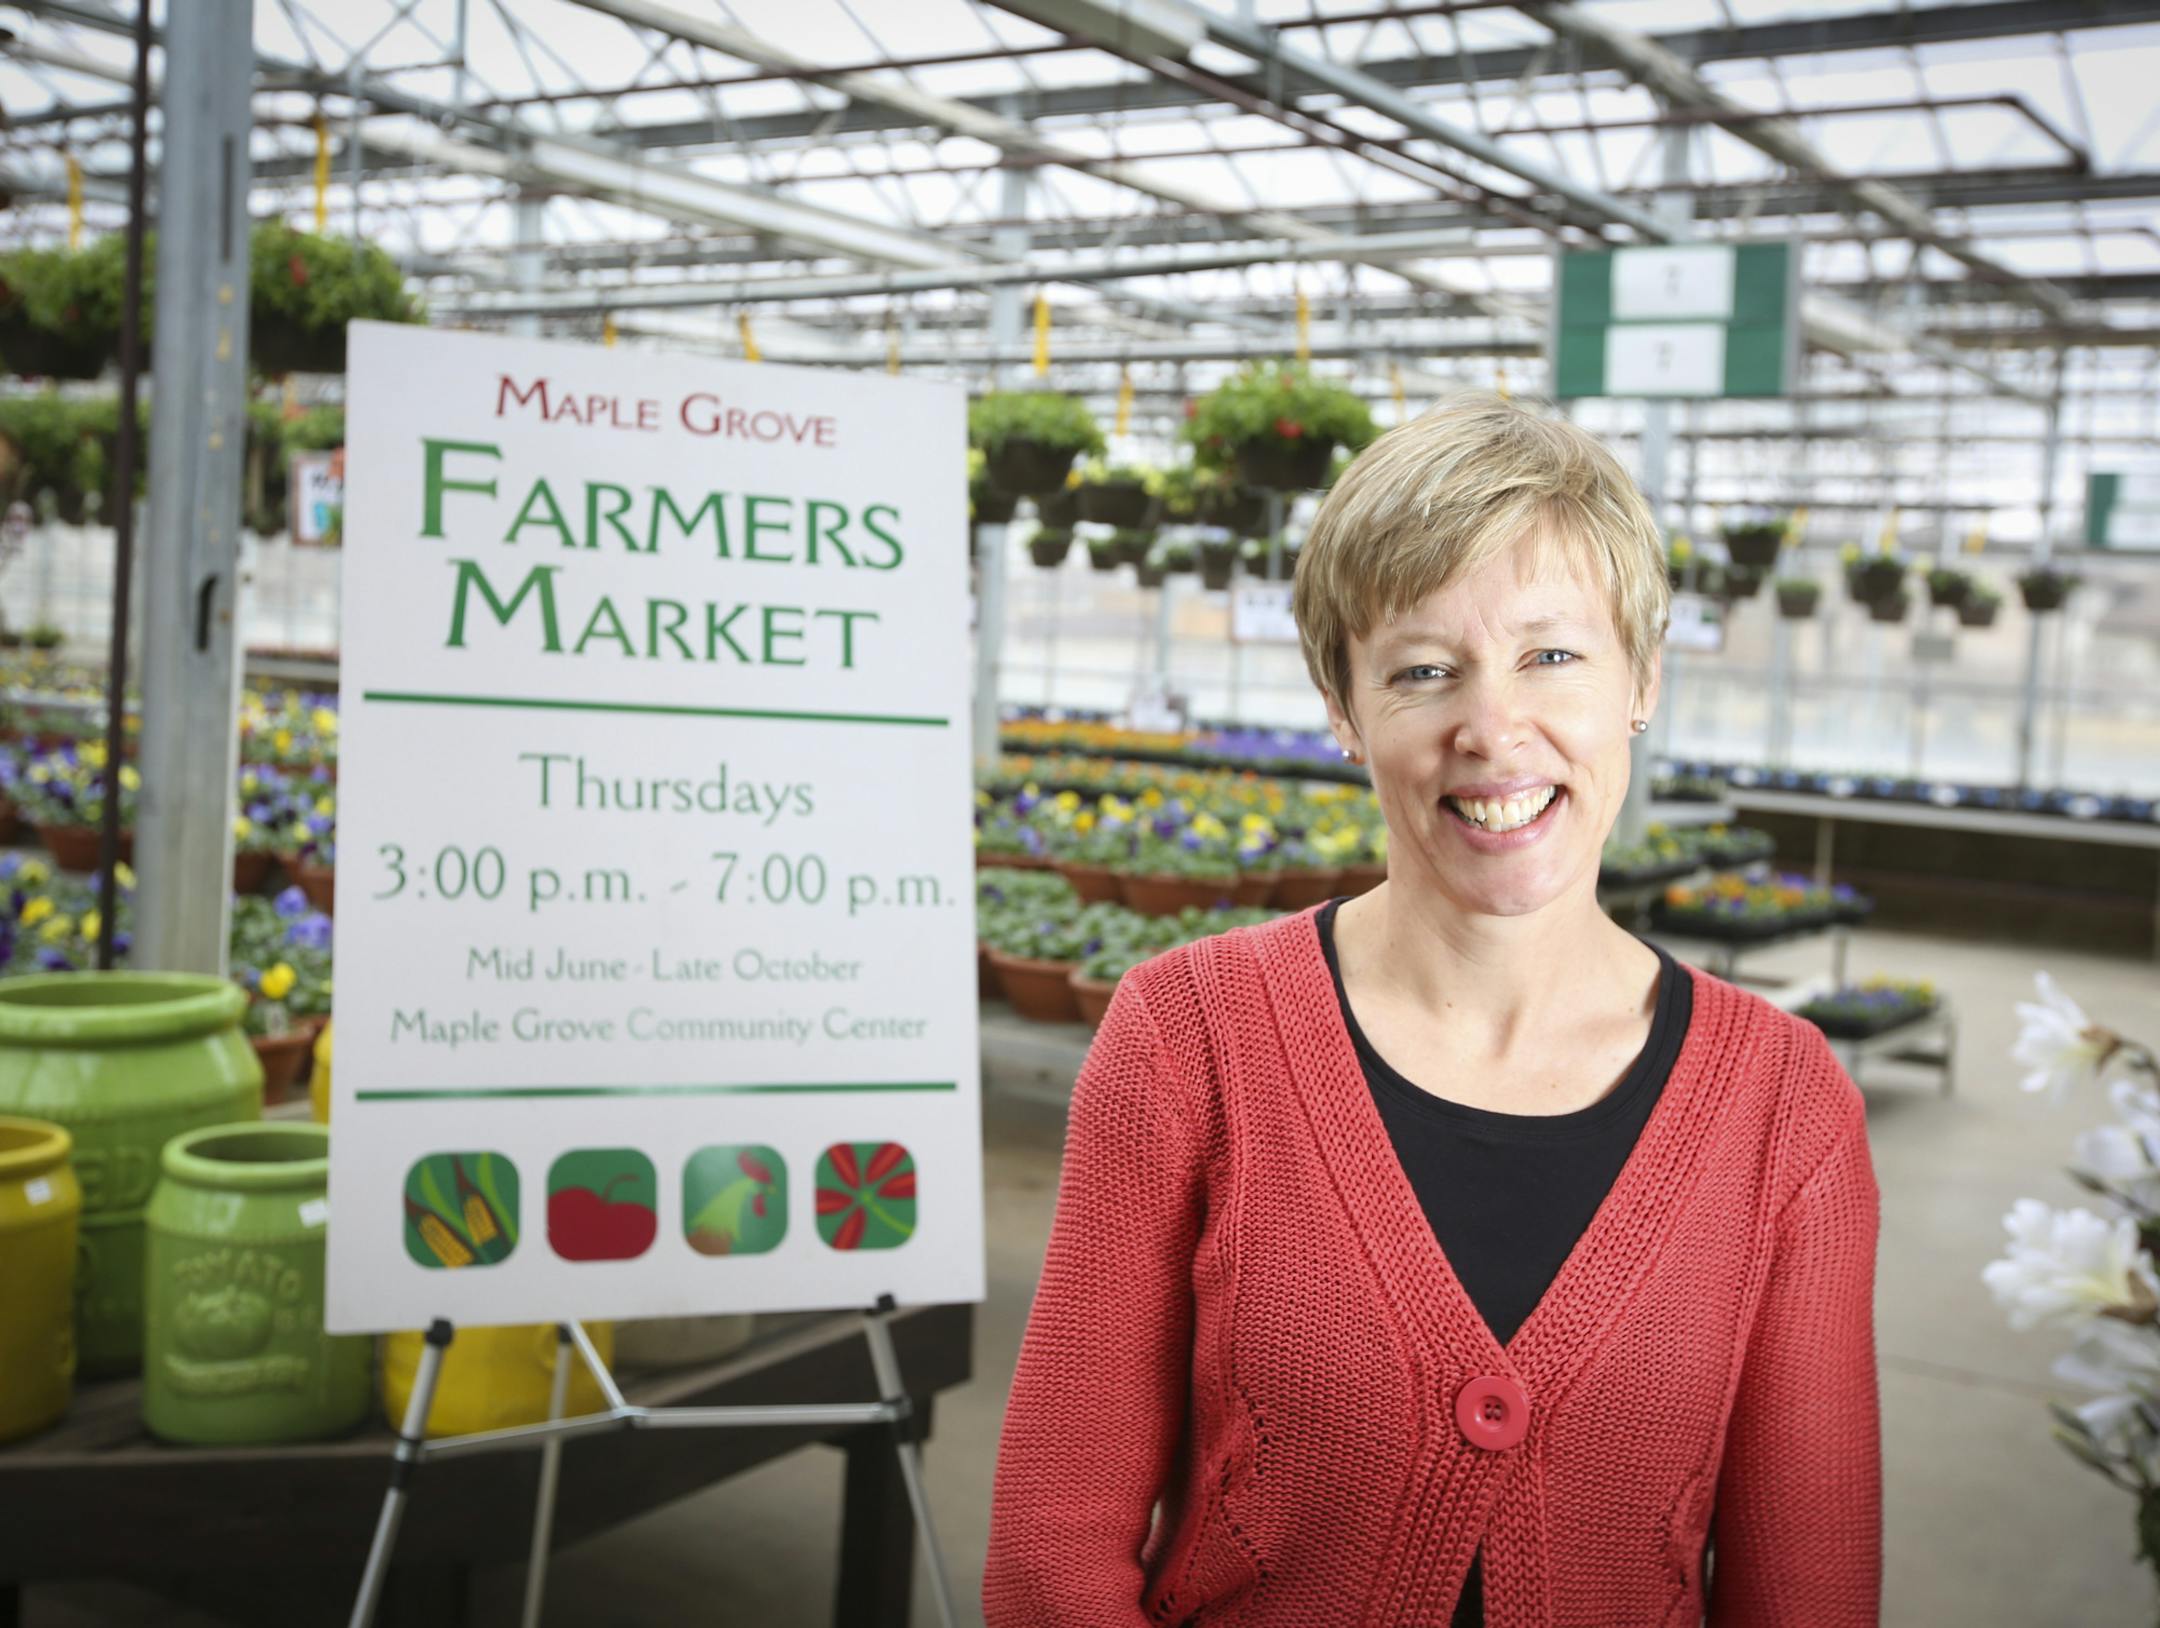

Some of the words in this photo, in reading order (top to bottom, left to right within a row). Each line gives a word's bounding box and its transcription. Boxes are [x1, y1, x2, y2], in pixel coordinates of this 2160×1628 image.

[495, 374, 659, 431] MAPLE
[679, 392, 837, 448] GROVE
[419, 437, 905, 572] FARMERS
[444, 558, 881, 670] MARKET
[518, 752, 815, 827] Thursdays
[373, 843, 507, 902] 3:00
[528, 867, 646, 913] p.m.
[711, 850, 828, 906] 7:00
[847, 874, 956, 918] p.m.
[466, 945, 535, 982] Mid
[732, 946, 865, 983] October
[390, 1007, 500, 1050] Maple
[511, 1007, 616, 1043] Grove
[626, 1007, 815, 1048] Community
[821, 1006, 929, 1042] Center
